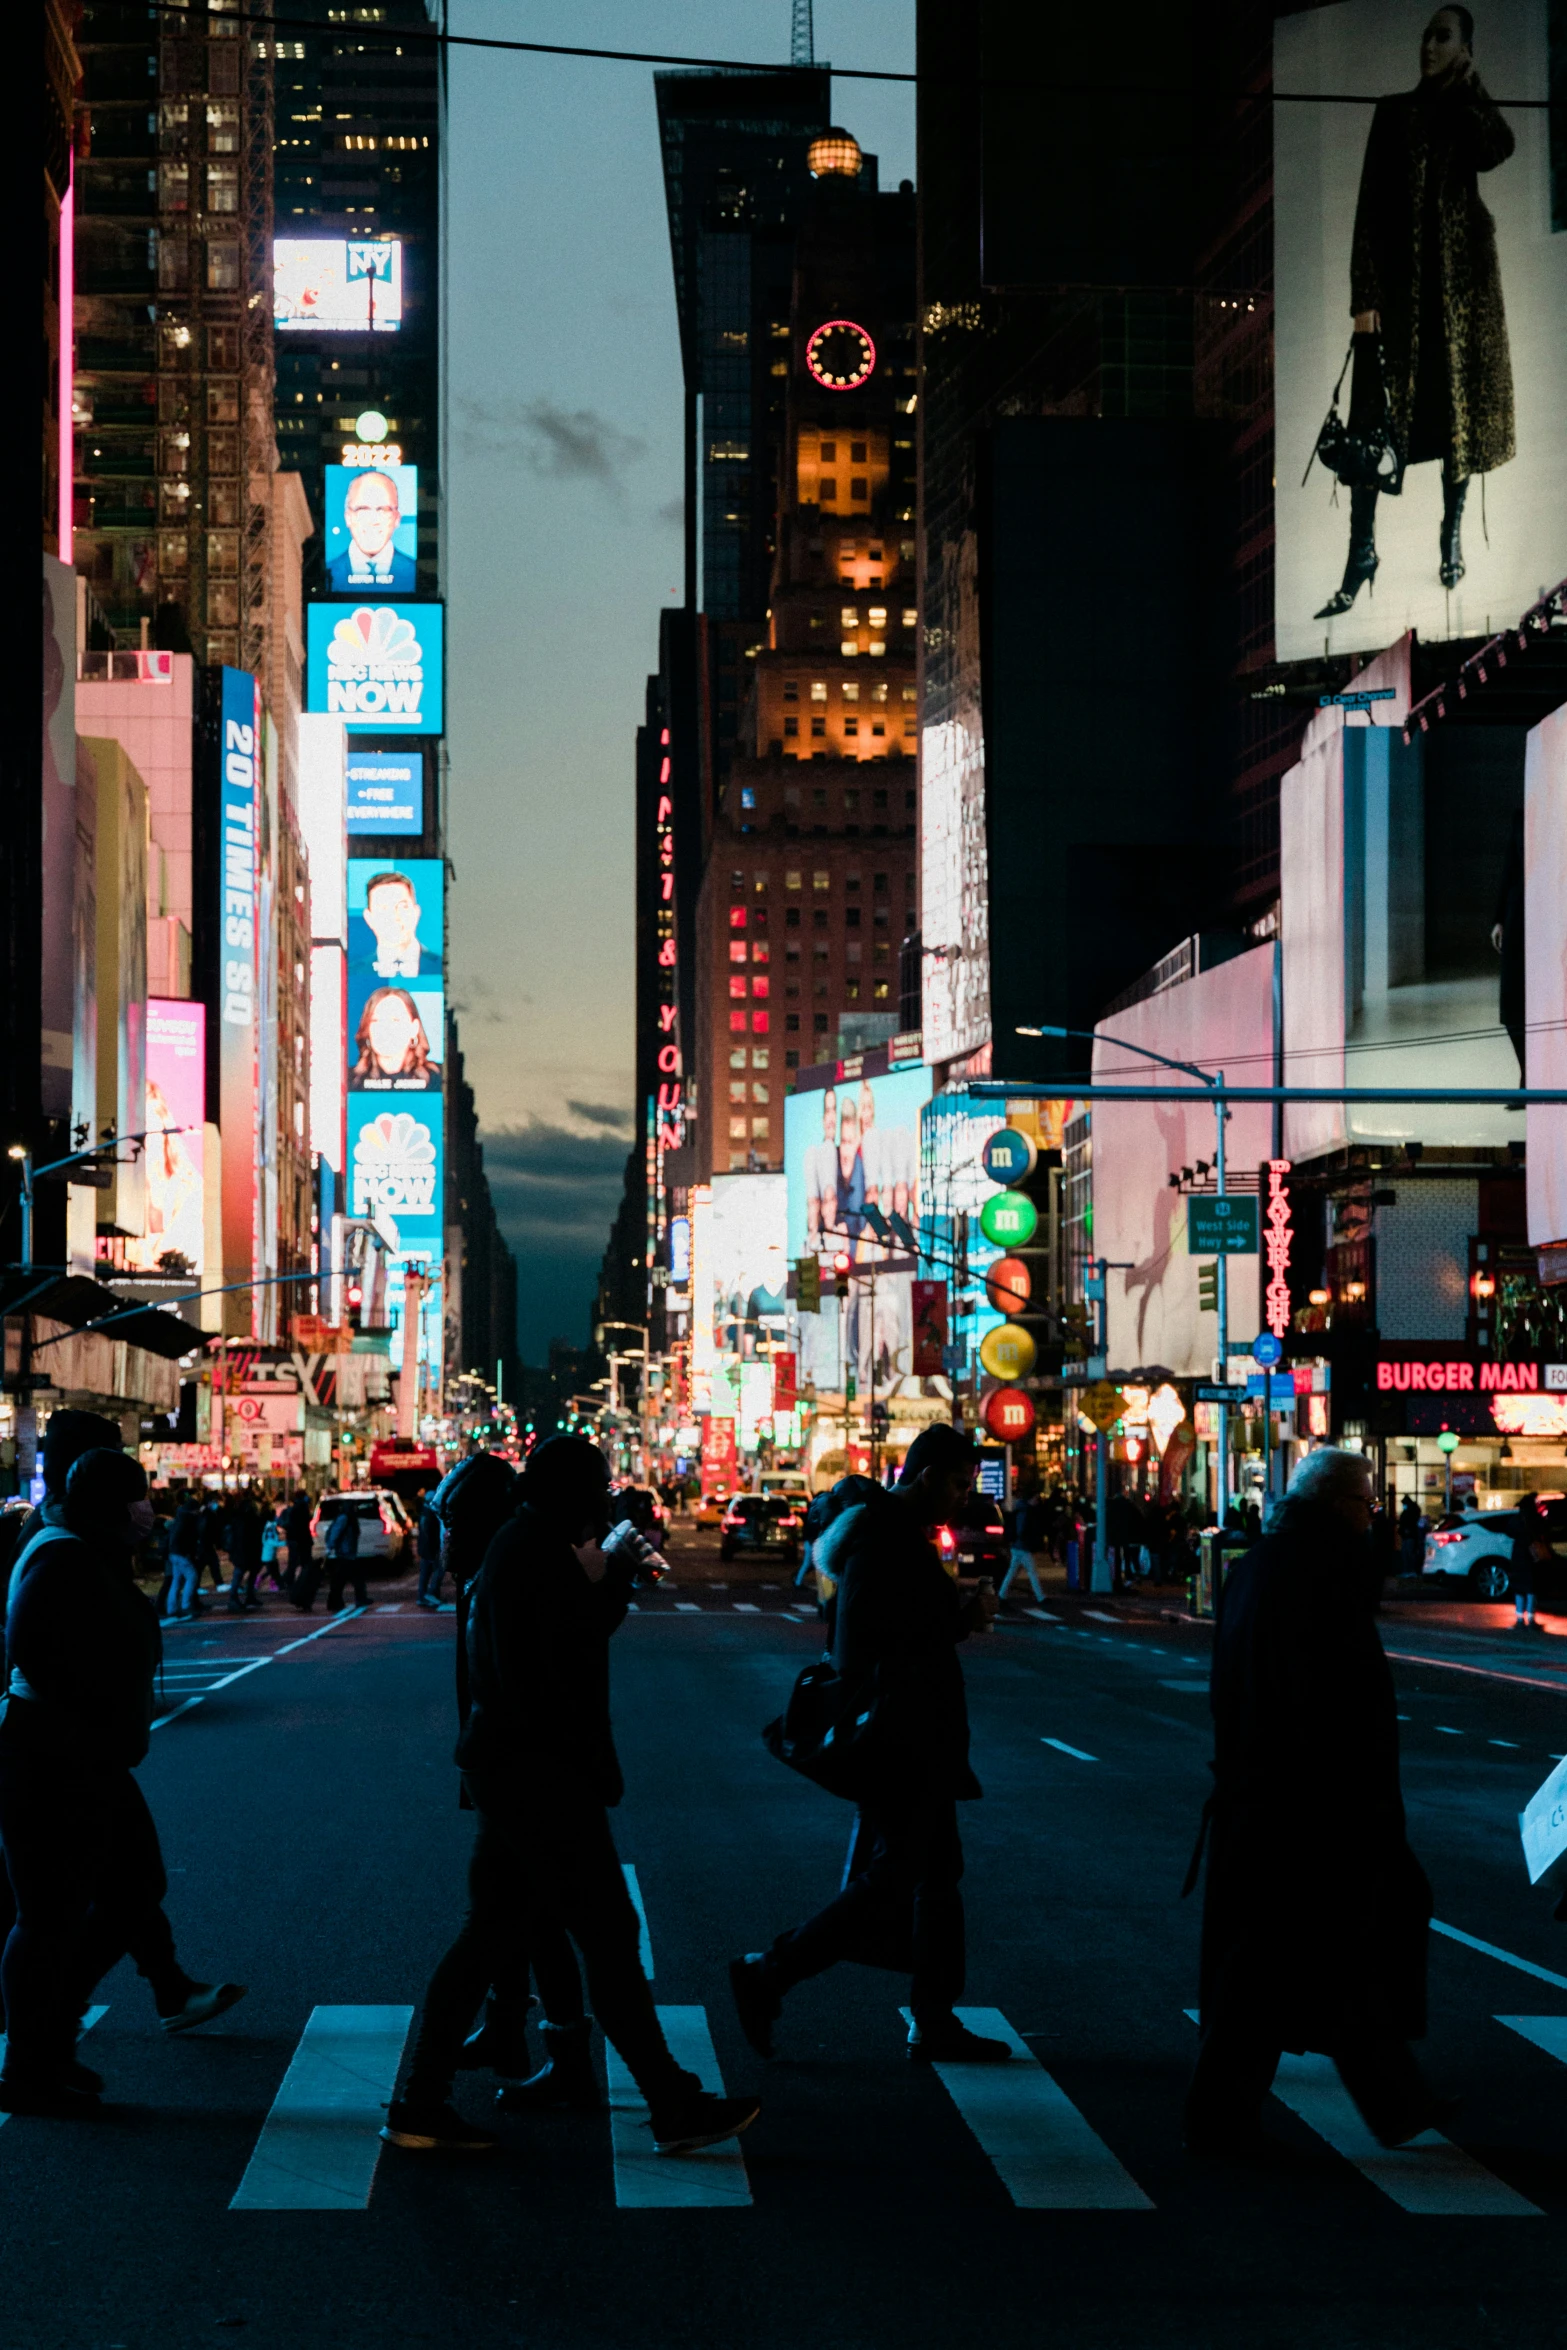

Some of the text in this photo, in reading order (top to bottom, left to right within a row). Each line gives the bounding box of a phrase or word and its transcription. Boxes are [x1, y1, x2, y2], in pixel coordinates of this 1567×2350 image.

[350, 252, 391, 276] NY
[342, 444, 402, 467] 2022
[327, 681, 424, 712] NOW
[225, 719, 254, 789] 20
[225, 801, 254, 951] TIMES
[992, 1147, 1013, 1168] m
[353, 1178, 436, 1205] NOW
[995, 1208, 1019, 1231] m
[1196, 1219, 1250, 1232] West Side
[1198, 1236, 1222, 1250] Hwy
[1263, 1159, 1295, 1338] PLAYWRIGHT
[1011, 1275, 1027, 1297] m
[997, 1342, 1019, 1361] m
[1376, 1361, 1538, 1391] BURGER MAN
[1552, 1369, 1567, 1384] FO
[1003, 1404, 1026, 1425] m
